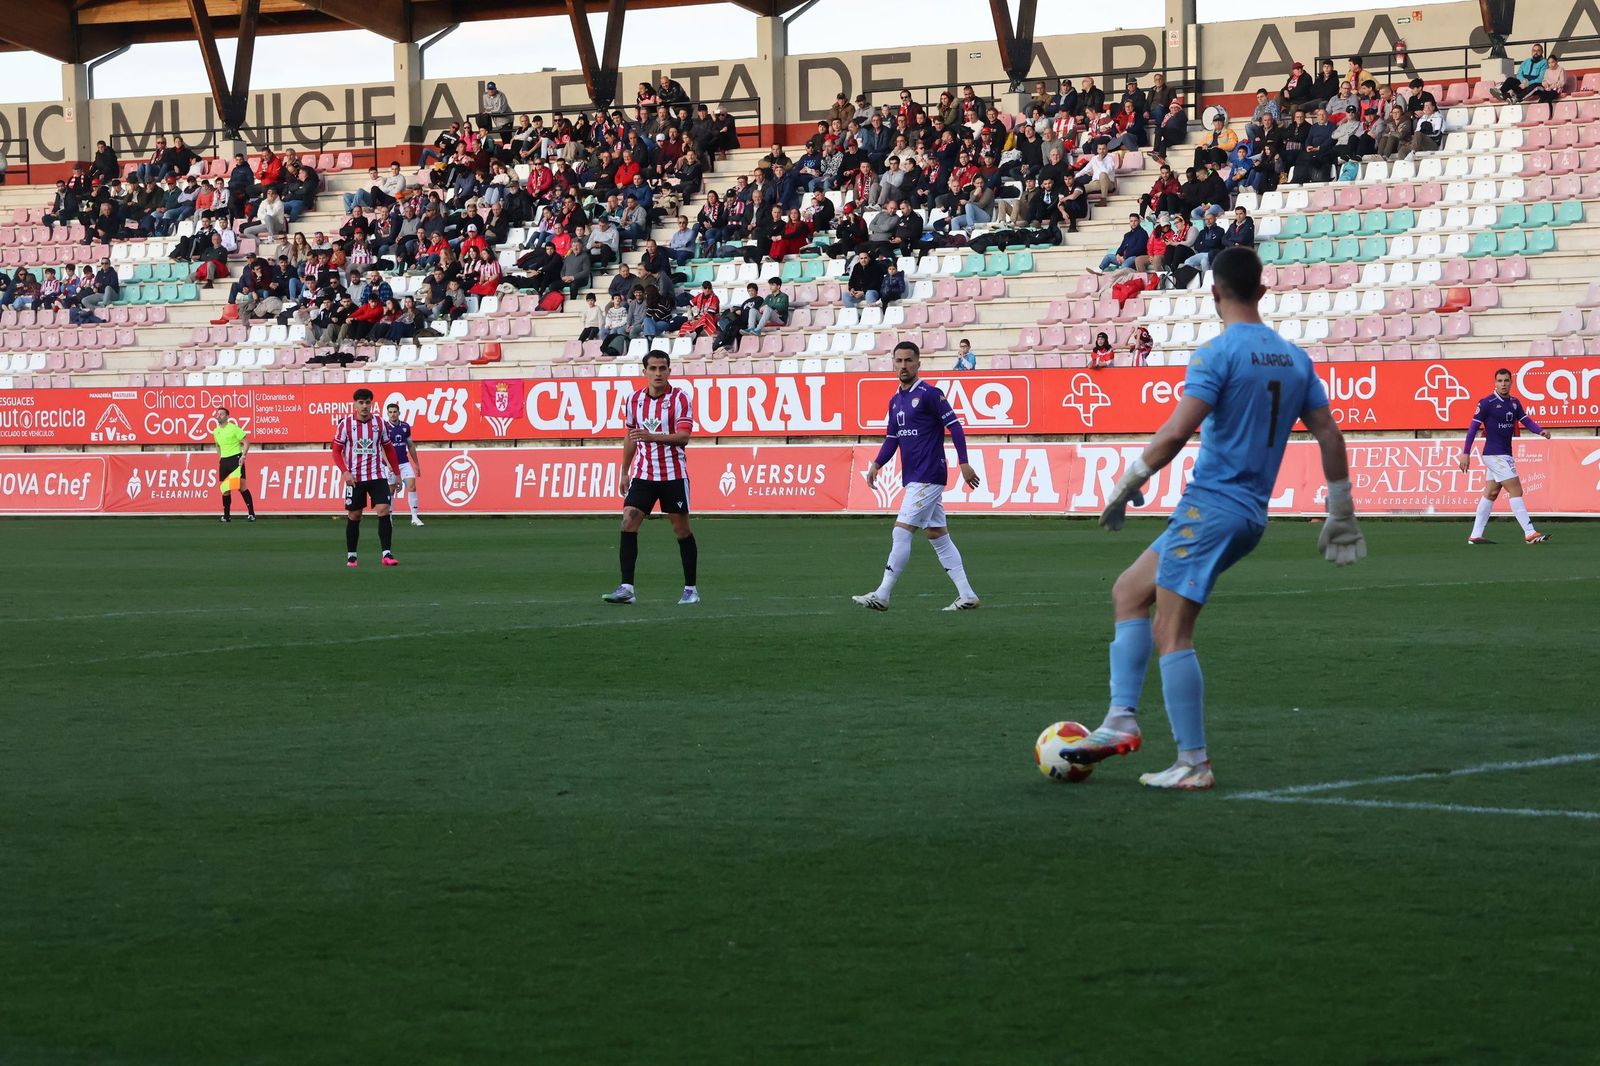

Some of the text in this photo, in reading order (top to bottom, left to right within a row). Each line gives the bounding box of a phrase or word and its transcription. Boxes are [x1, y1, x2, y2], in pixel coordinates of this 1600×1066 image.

[799, 52, 912, 121] DE
[144, 389, 252, 409] Clínica Dental
[263, 393, 287, 401] Donantes
[0, 407, 86, 428] utorecicla
[256, 404, 273, 413] Sangre
[283, 404, 296, 412] Local
[1267, 380, 1281, 448] 1
[1525, 404, 1600, 415] MBUTIDO
[255, 415, 280, 423] ZAMORA
[91, 426, 137, 441] El Viso
[255, 427, 266, 435] 980
[1346, 445, 1487, 468] TERNERA
[145, 468, 217, 488] VERSUS
[539, 462, 627, 498] FEDERA
[740, 464, 826, 485] VERSUS
[1371, 469, 1487, 493] ALISTE
[0, 472, 92, 501] OVA Chef
[151, 489, 209, 499] E-LEARNING
[748, 486, 816, 497] E-LEARNING
